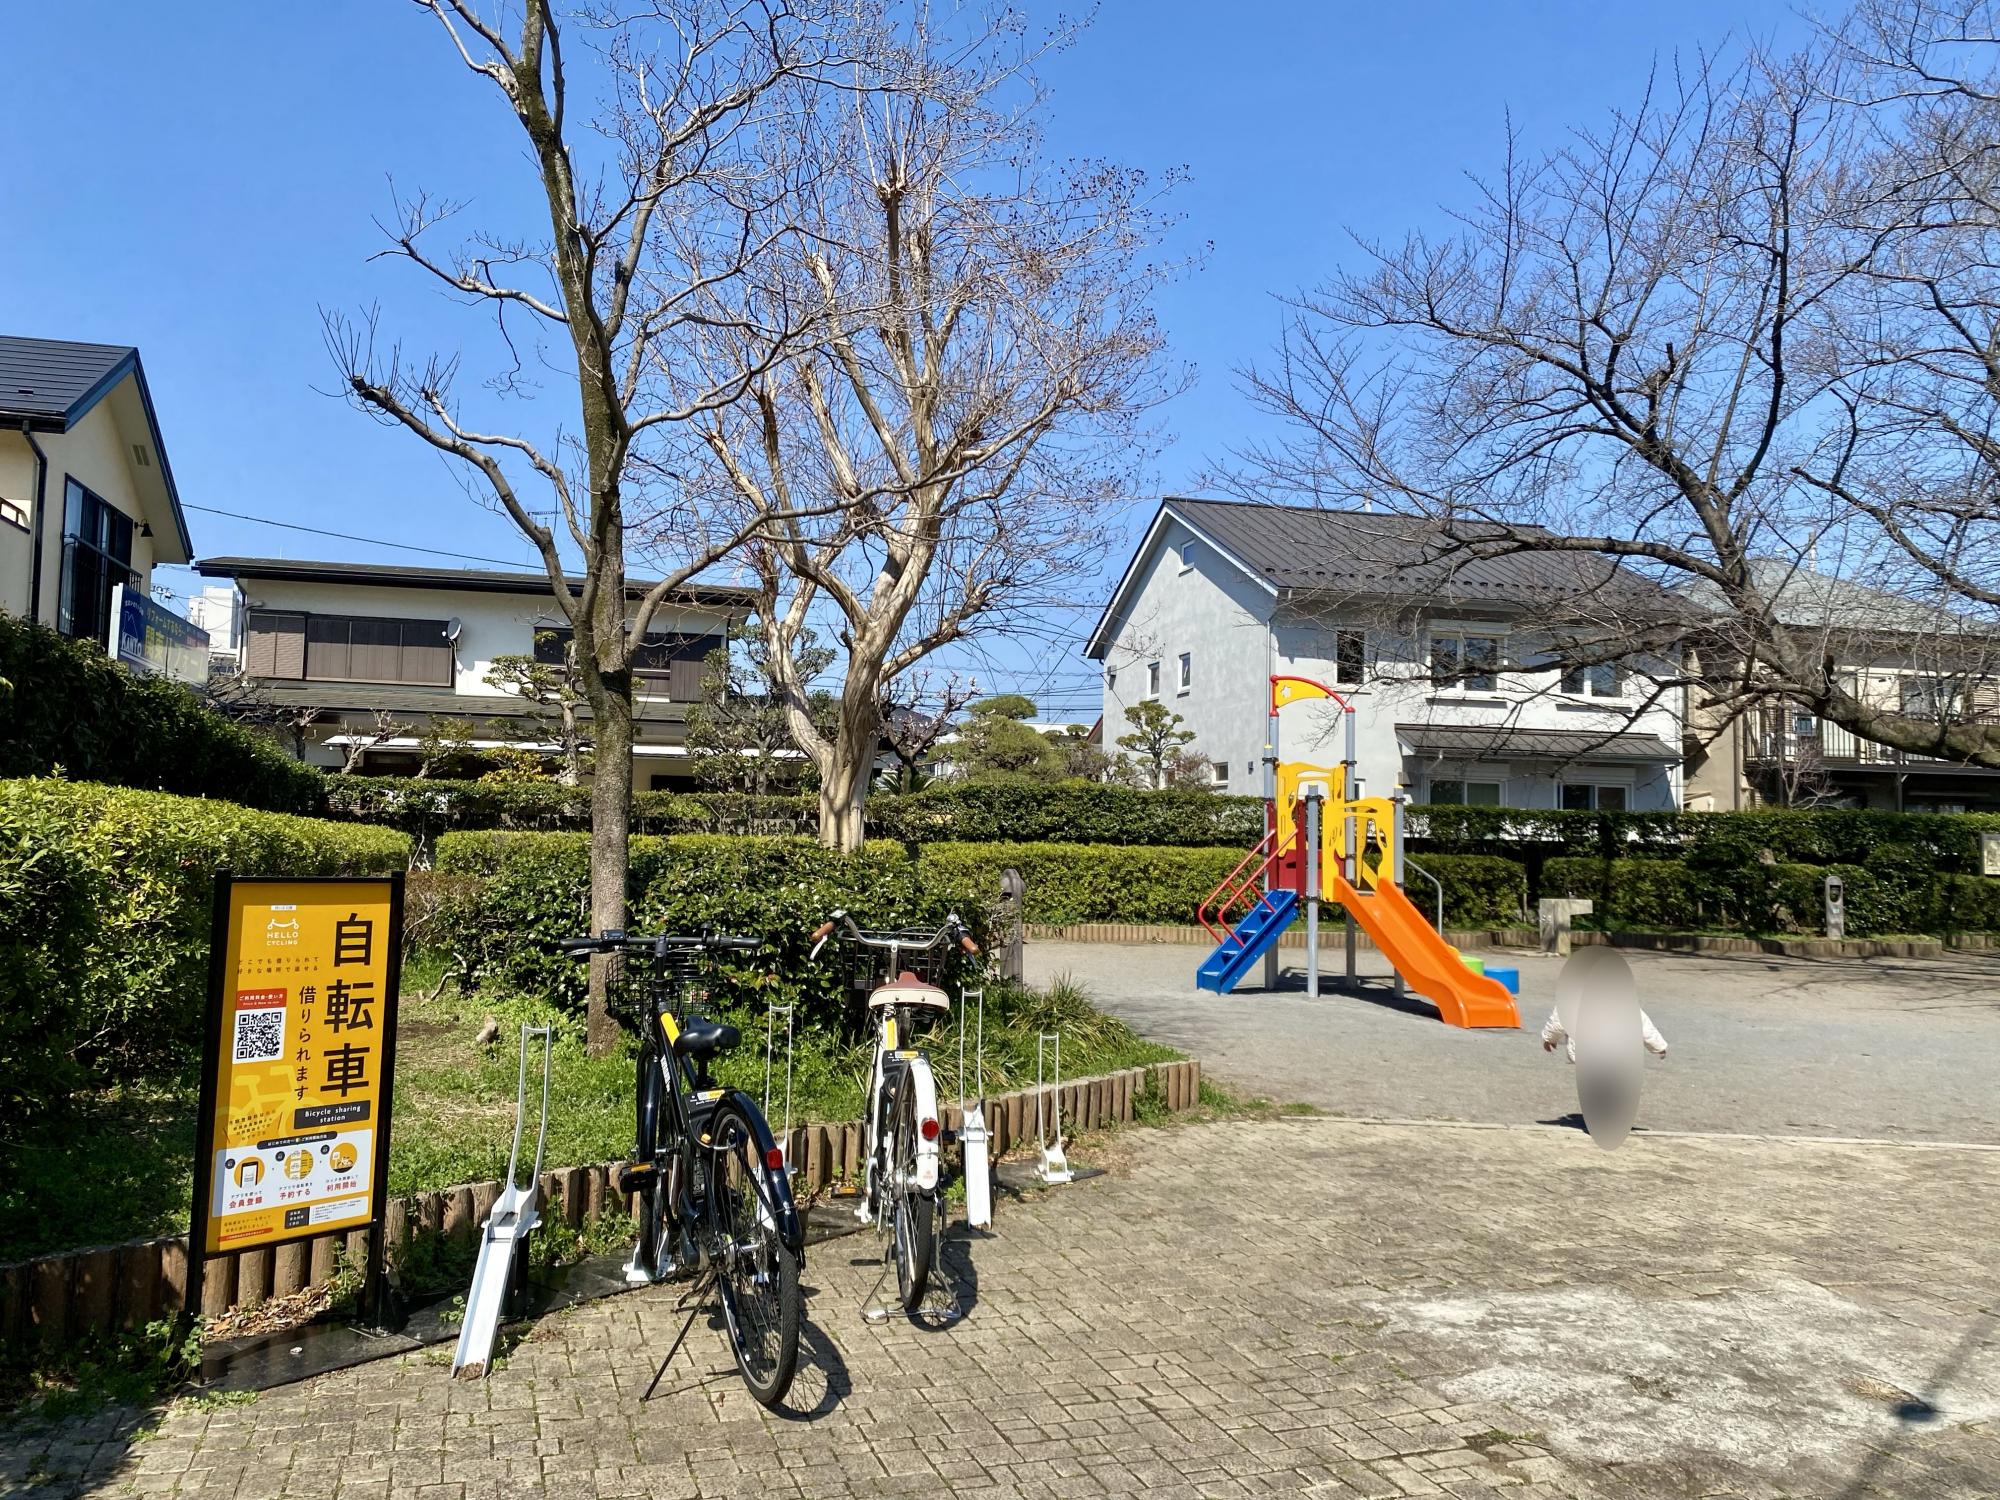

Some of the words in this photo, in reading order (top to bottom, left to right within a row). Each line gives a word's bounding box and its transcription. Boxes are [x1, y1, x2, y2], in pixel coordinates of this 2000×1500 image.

[121, 631, 142, 656] KANTO
[266, 931, 299, 939] HELLO
[320, 912, 374, 1099] 自転車
[294, 985, 317, 1101] 借りられます
[304, 1109, 331, 1118] Bicycle
[335, 1104, 362, 1114] sharing
[319, 1114, 346, 1124] station
[279, 1188, 311, 1200] 予約する
[228, 1196, 263, 1209] 会員登録
